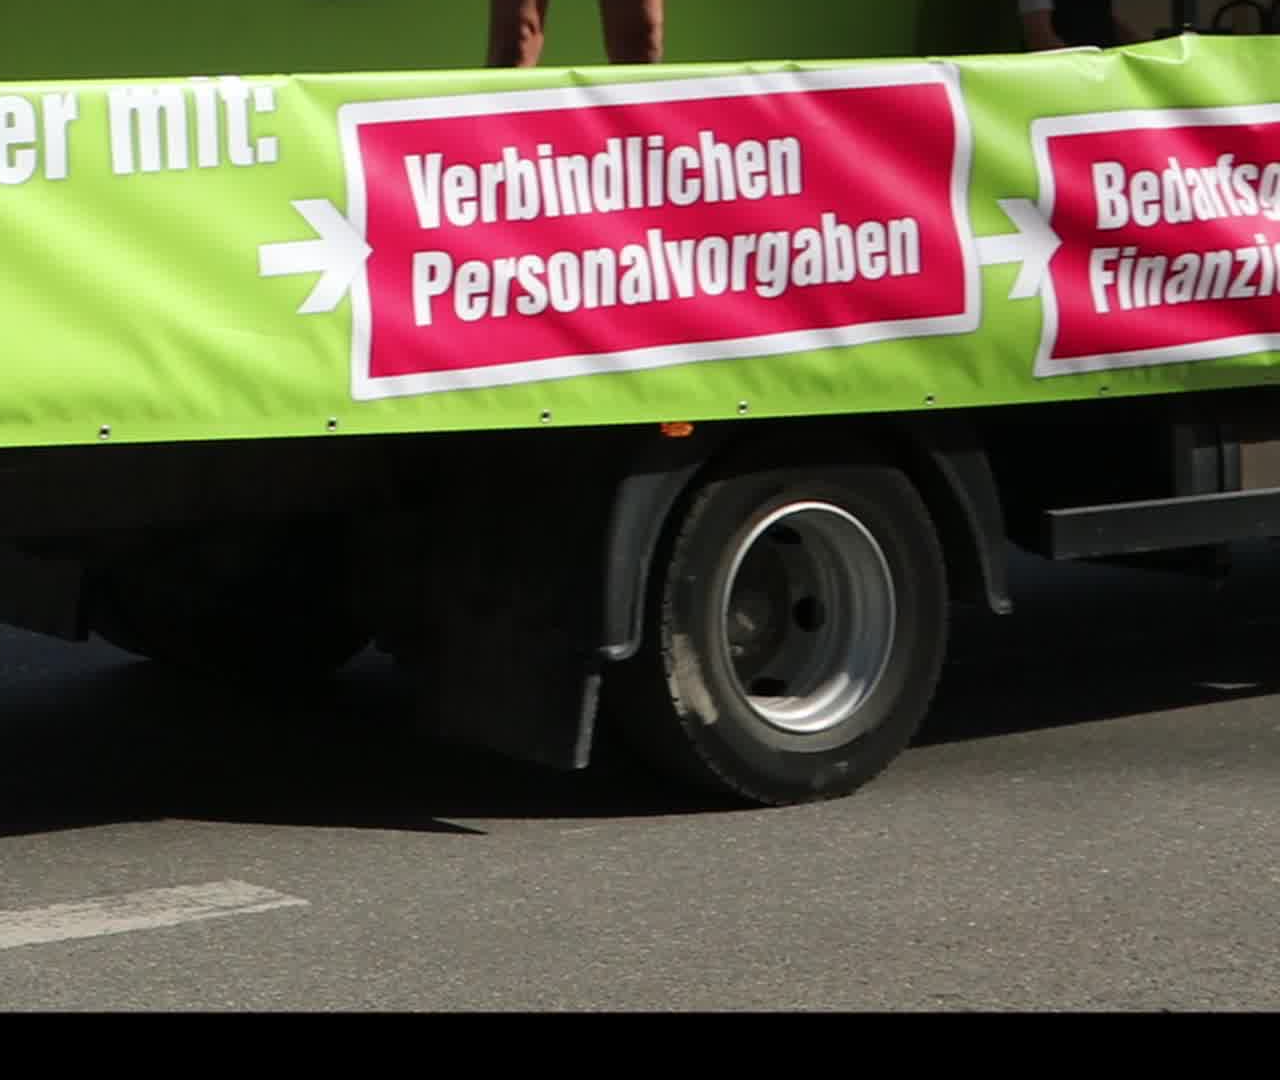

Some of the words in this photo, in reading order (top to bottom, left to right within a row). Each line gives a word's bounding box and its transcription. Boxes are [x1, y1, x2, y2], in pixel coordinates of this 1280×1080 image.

[107, 75, 278, 176] mit:
[402, 131, 802, 230] Verbindlichen
[412, 217, 922, 326] Personalvorgaben
[1090, 233, 1280, 314] Finanzi
